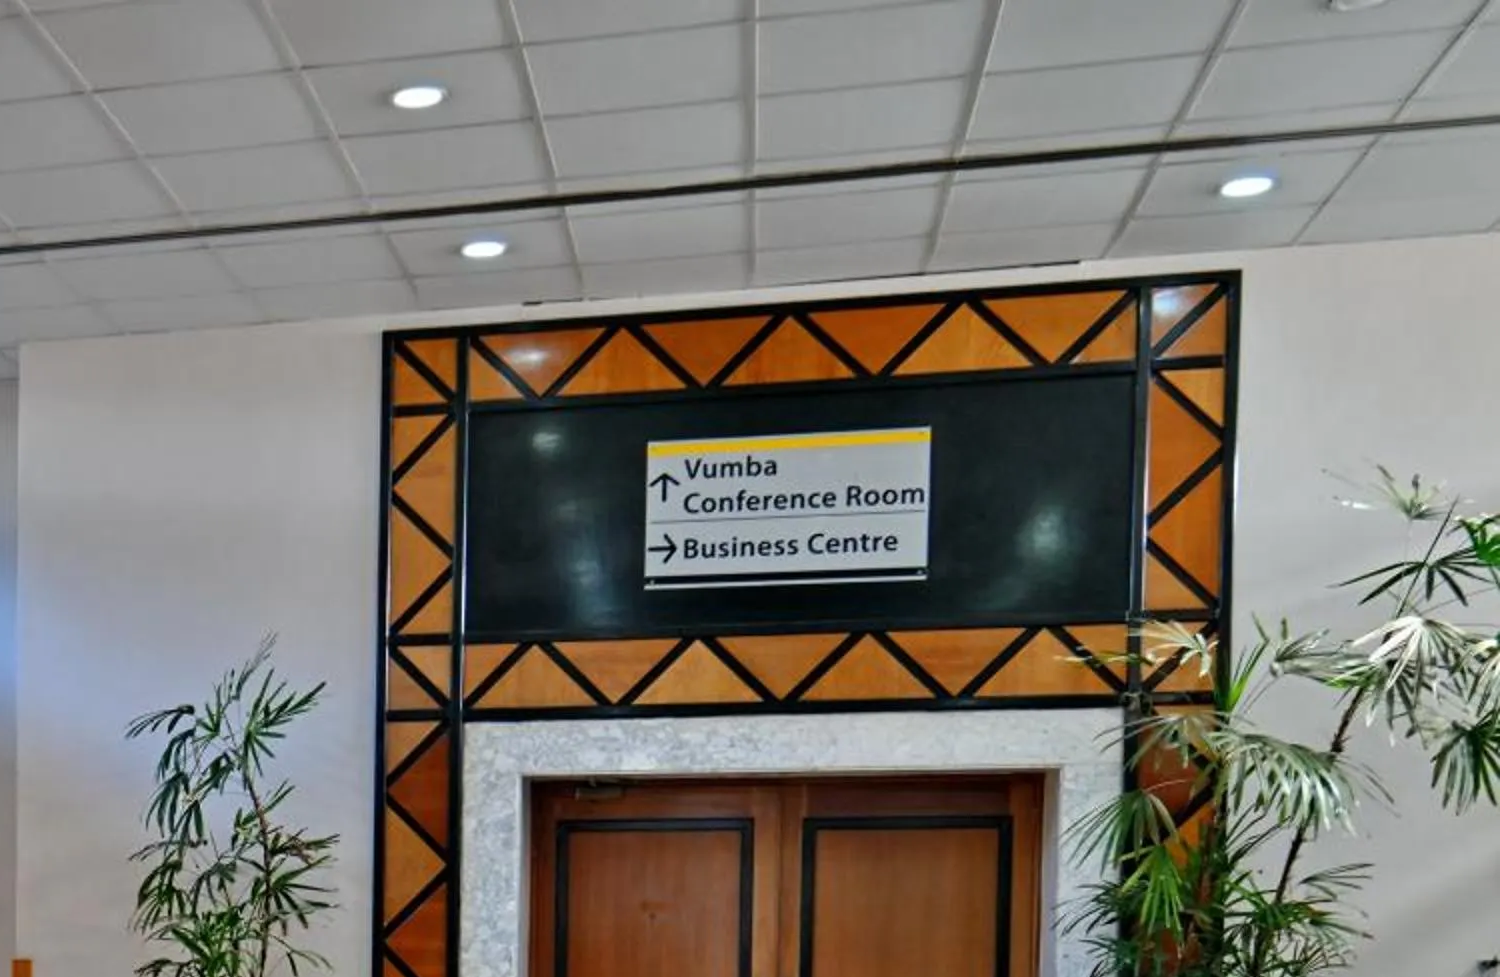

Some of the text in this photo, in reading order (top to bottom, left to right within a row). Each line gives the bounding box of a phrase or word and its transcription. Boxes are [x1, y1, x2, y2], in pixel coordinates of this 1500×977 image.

[685, 455, 778, 480] Vumba
[683, 485, 925, 515] Conference Room
[683, 533, 899, 560] Business Centre
